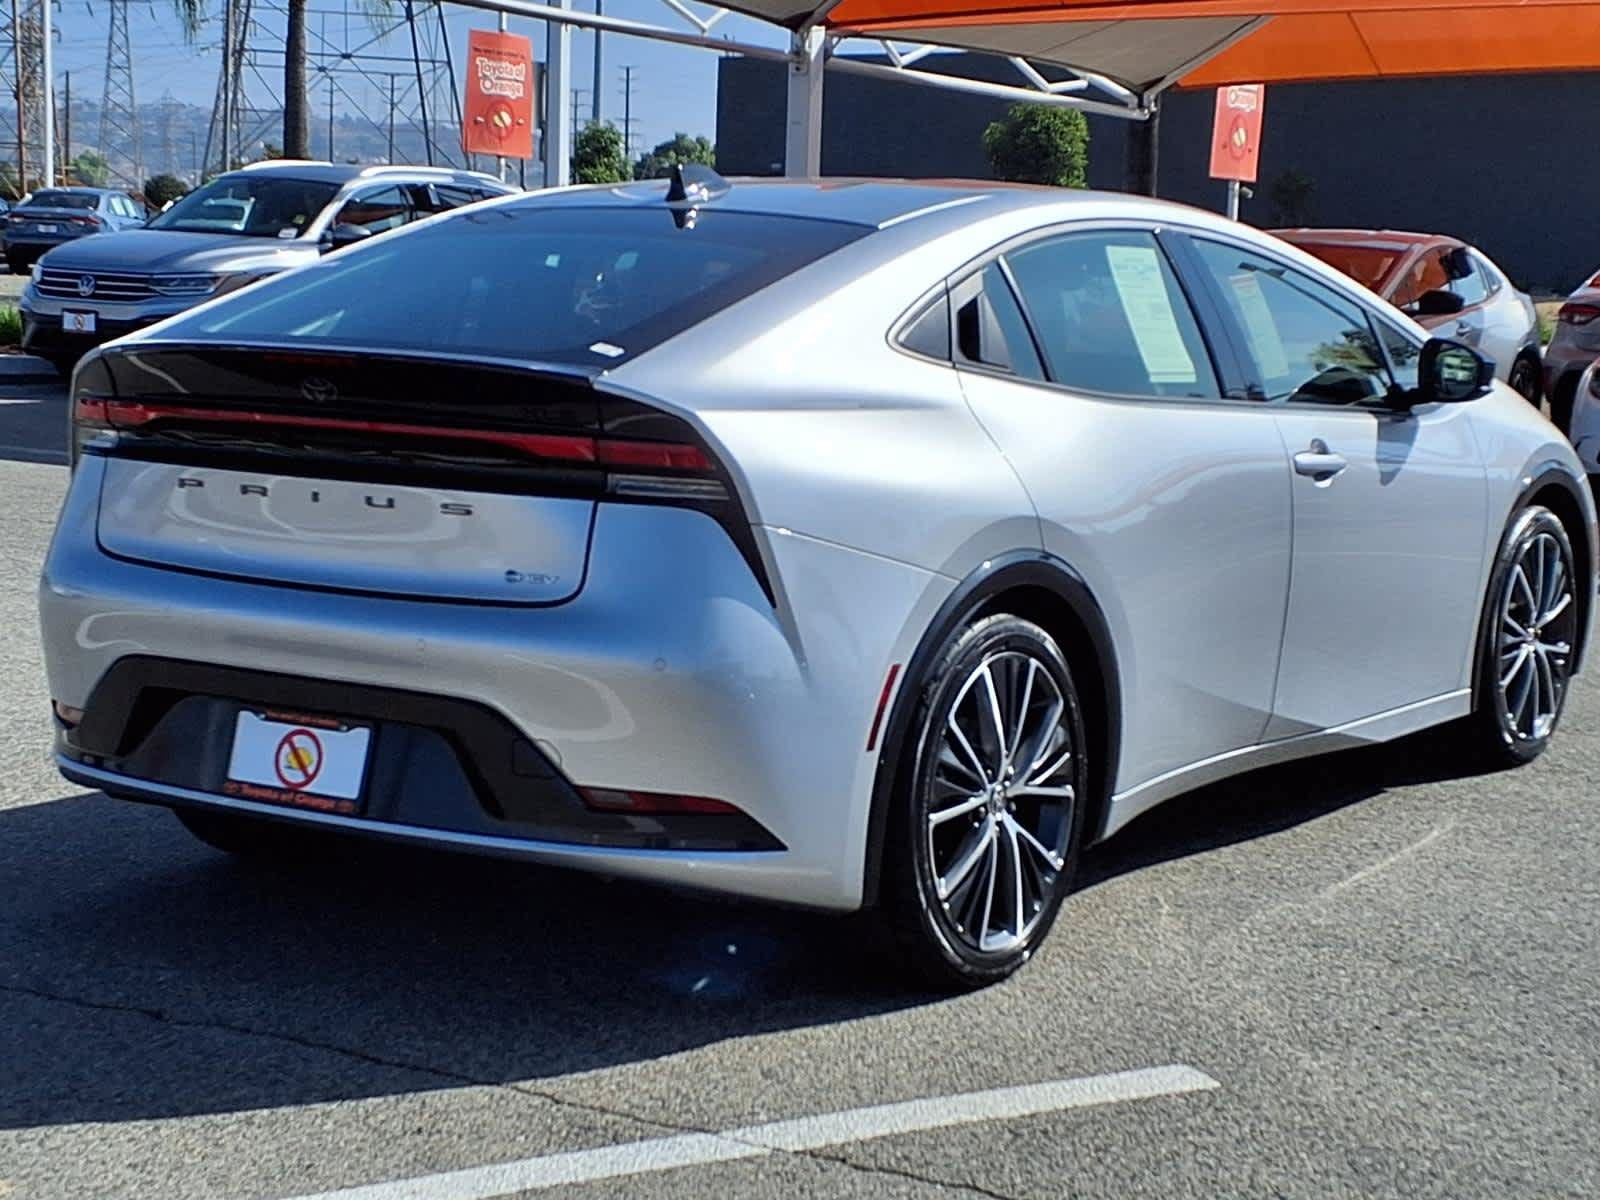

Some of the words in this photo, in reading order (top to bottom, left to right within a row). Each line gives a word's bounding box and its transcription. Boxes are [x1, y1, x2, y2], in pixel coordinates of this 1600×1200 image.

[477, 58, 513, 78] Toyota
[482, 78, 522, 97] Orange
[178, 478, 473, 516] PRIUS
